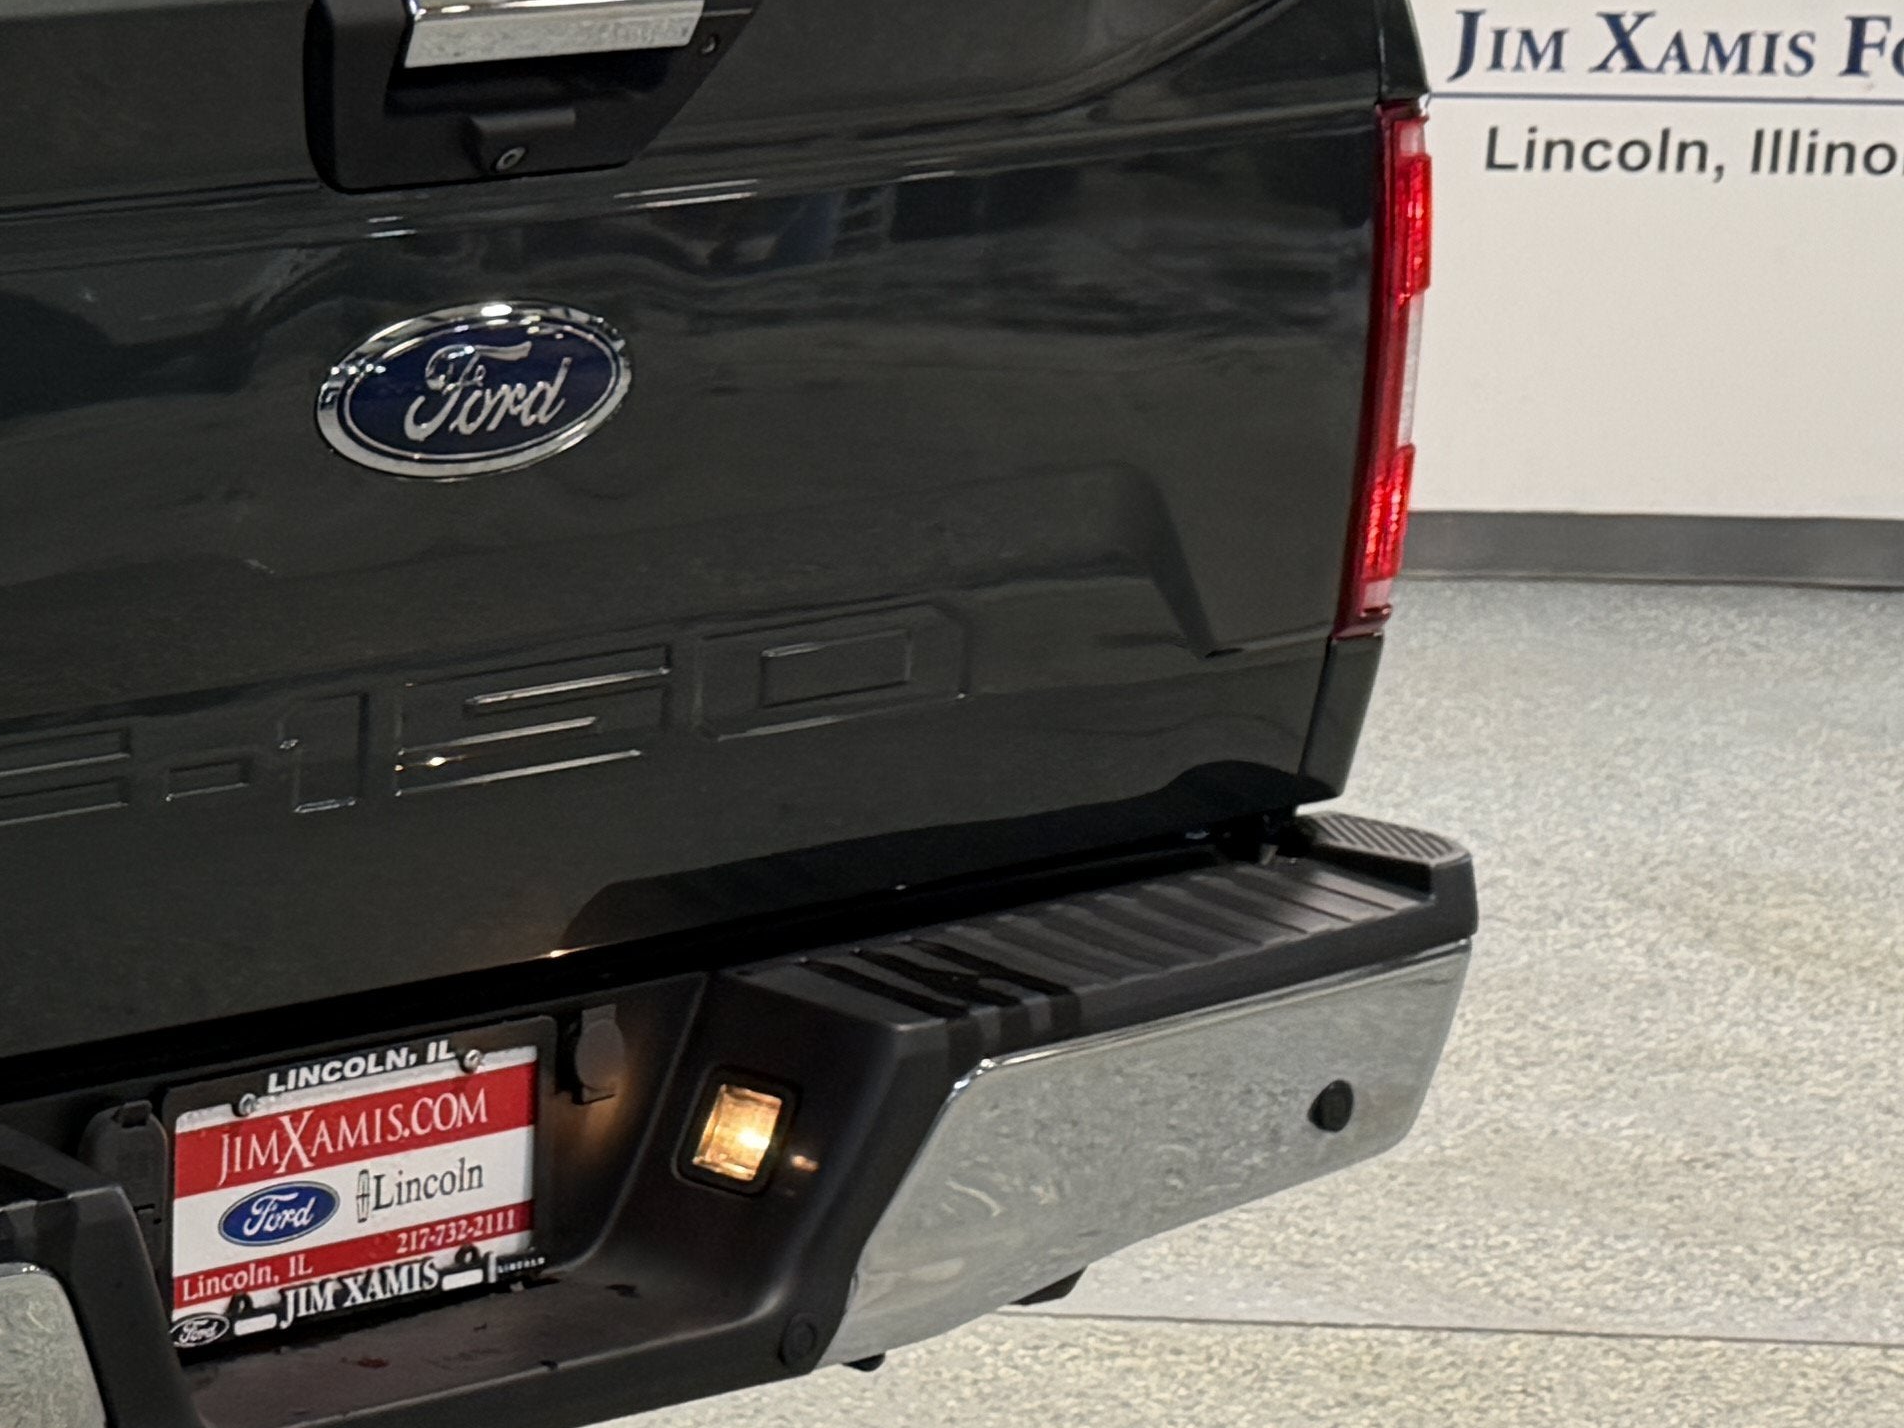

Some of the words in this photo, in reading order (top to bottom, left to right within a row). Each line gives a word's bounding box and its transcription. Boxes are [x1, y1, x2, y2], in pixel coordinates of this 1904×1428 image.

[1447, 8, 1568, 83] JIM
[1589, 10, 1817, 76] XAMIS
[1484, 125, 1725, 183] Lincoln,
[1750, 128, 1904, 176] Illino
[403, 340, 573, 442] Ford
[266, 1046, 418, 1094] LINCOLN,
[425, 1039, 457, 1064] IL
[218, 1086, 489, 1188] JIMXAMIS.COM
[372, 1156, 484, 1211] Lincoln
[243, 1192, 315, 1237] Ford
[396, 1209, 516, 1254] 217-732-2111
[182, 1262, 280, 1302] Lincoln,
[288, 1253, 314, 1279] IL
[278, 1279, 337, 1330] JIM
[342, 1259, 440, 1309] XAMIS
[178, 1318, 219, 1344] Ford
